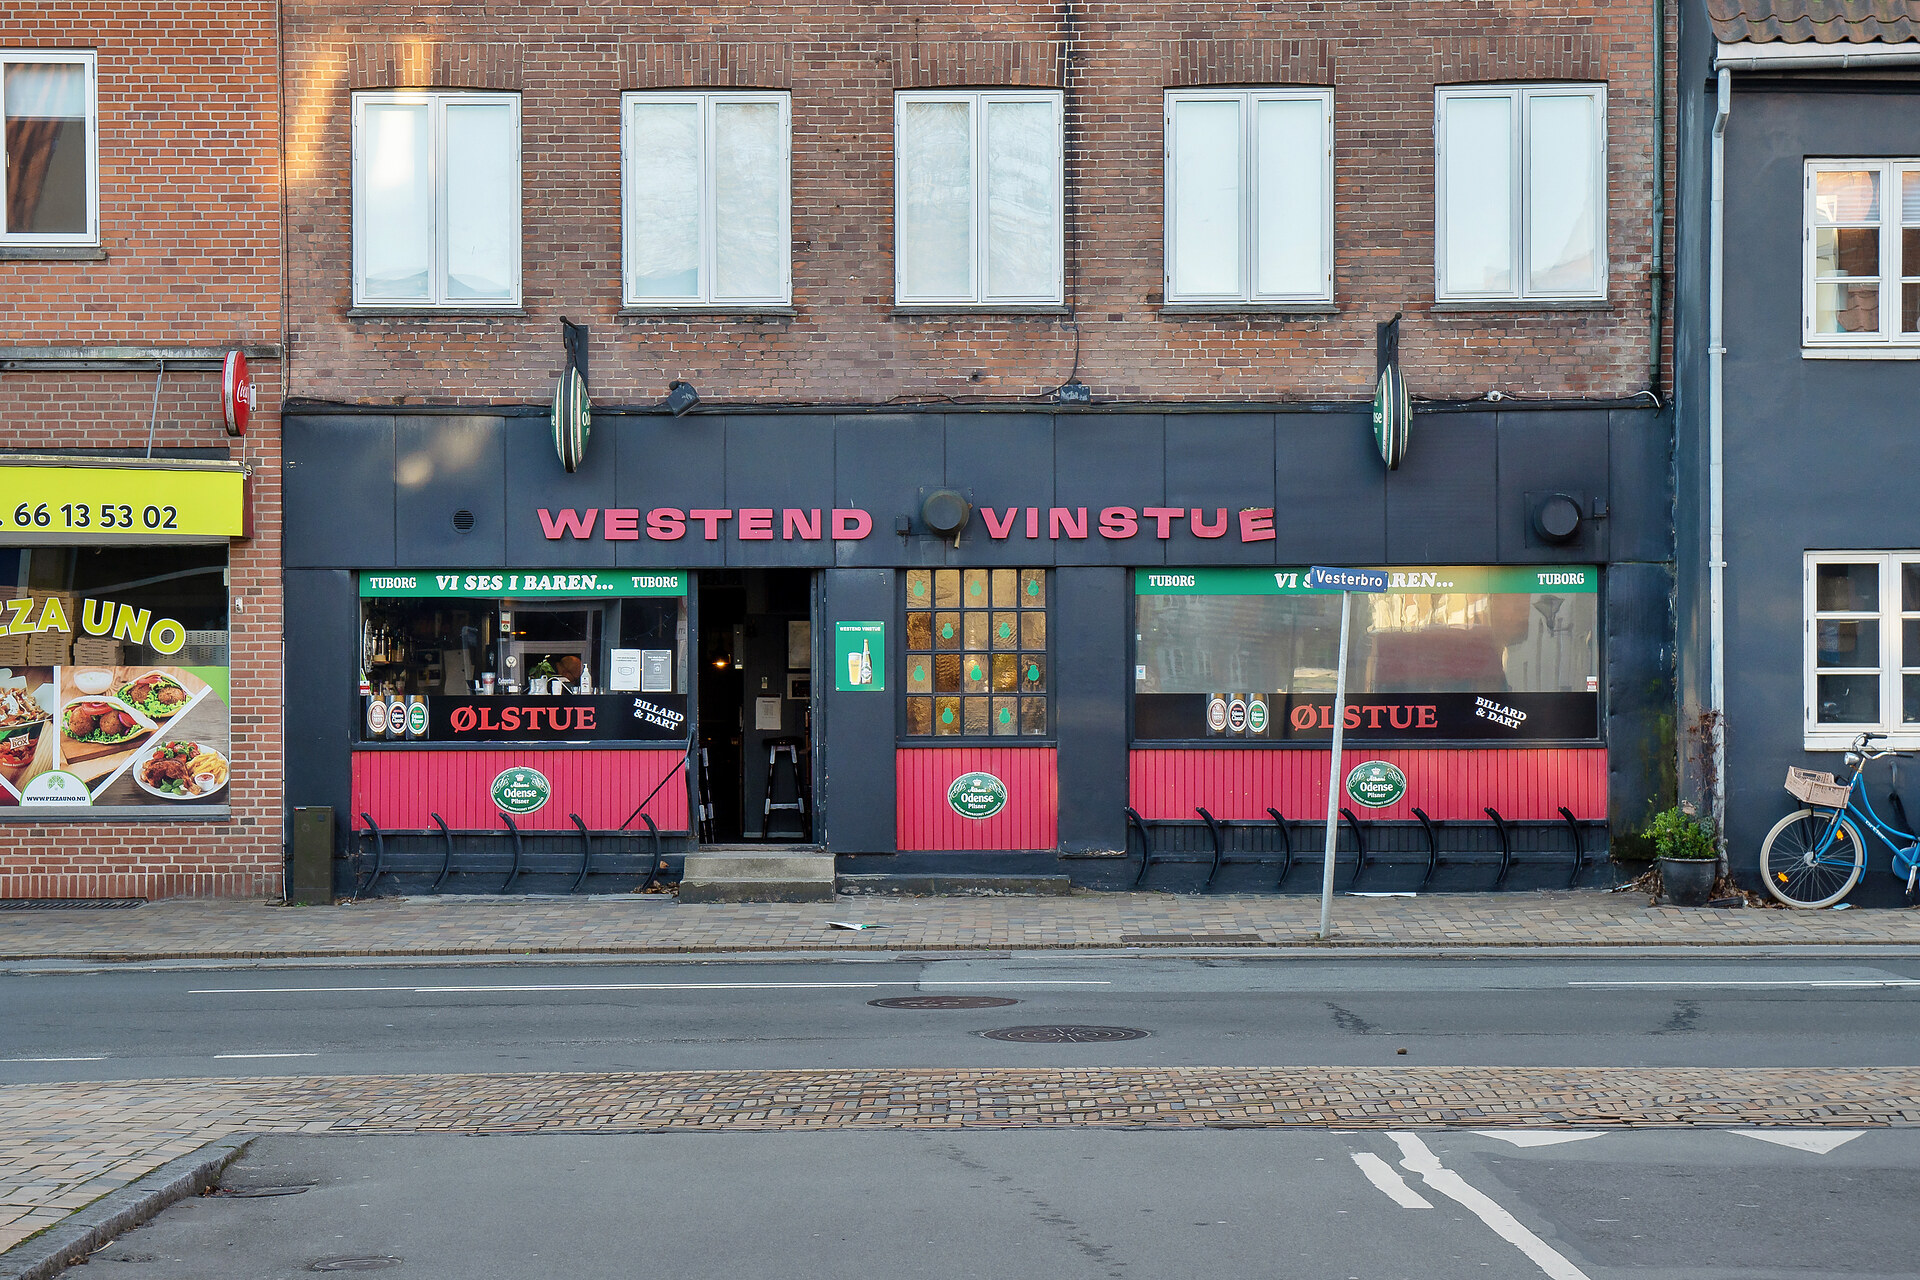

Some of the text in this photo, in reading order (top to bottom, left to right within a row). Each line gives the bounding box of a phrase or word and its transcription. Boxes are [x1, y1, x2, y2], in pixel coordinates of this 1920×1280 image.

[13, 502, 178, 529] 66 13 53 02
[537, 506, 1276, 543] WESTEND VINSTUE
[370, 577, 416, 588] TUBORG
[436, 575, 614, 590] VI SES I BAREN...
[632, 576, 678, 588] TUBORG
[1149, 574, 1195, 587] TUBORG
[1274, 573, 1298, 588] VI
[1388, 572, 1454, 588] REN...
[1316, 569, 1383, 587] Vesterbro
[1537, 573, 1585, 585] TUBORG
[82, 598, 186, 655] UNO
[633, 698, 684, 722] BILLARD
[1290, 703, 1438, 731] ØLSTUE
[1475, 696, 1527, 721] BILLARD
[450, 705, 597, 733] ØLSTUE
[634, 709, 678, 731] & DART
[1476, 707, 1521, 729] & DART
[503, 788, 537, 798] Odense
[1359, 782, 1394, 792] Odense
[960, 793, 994, 803] Odense
